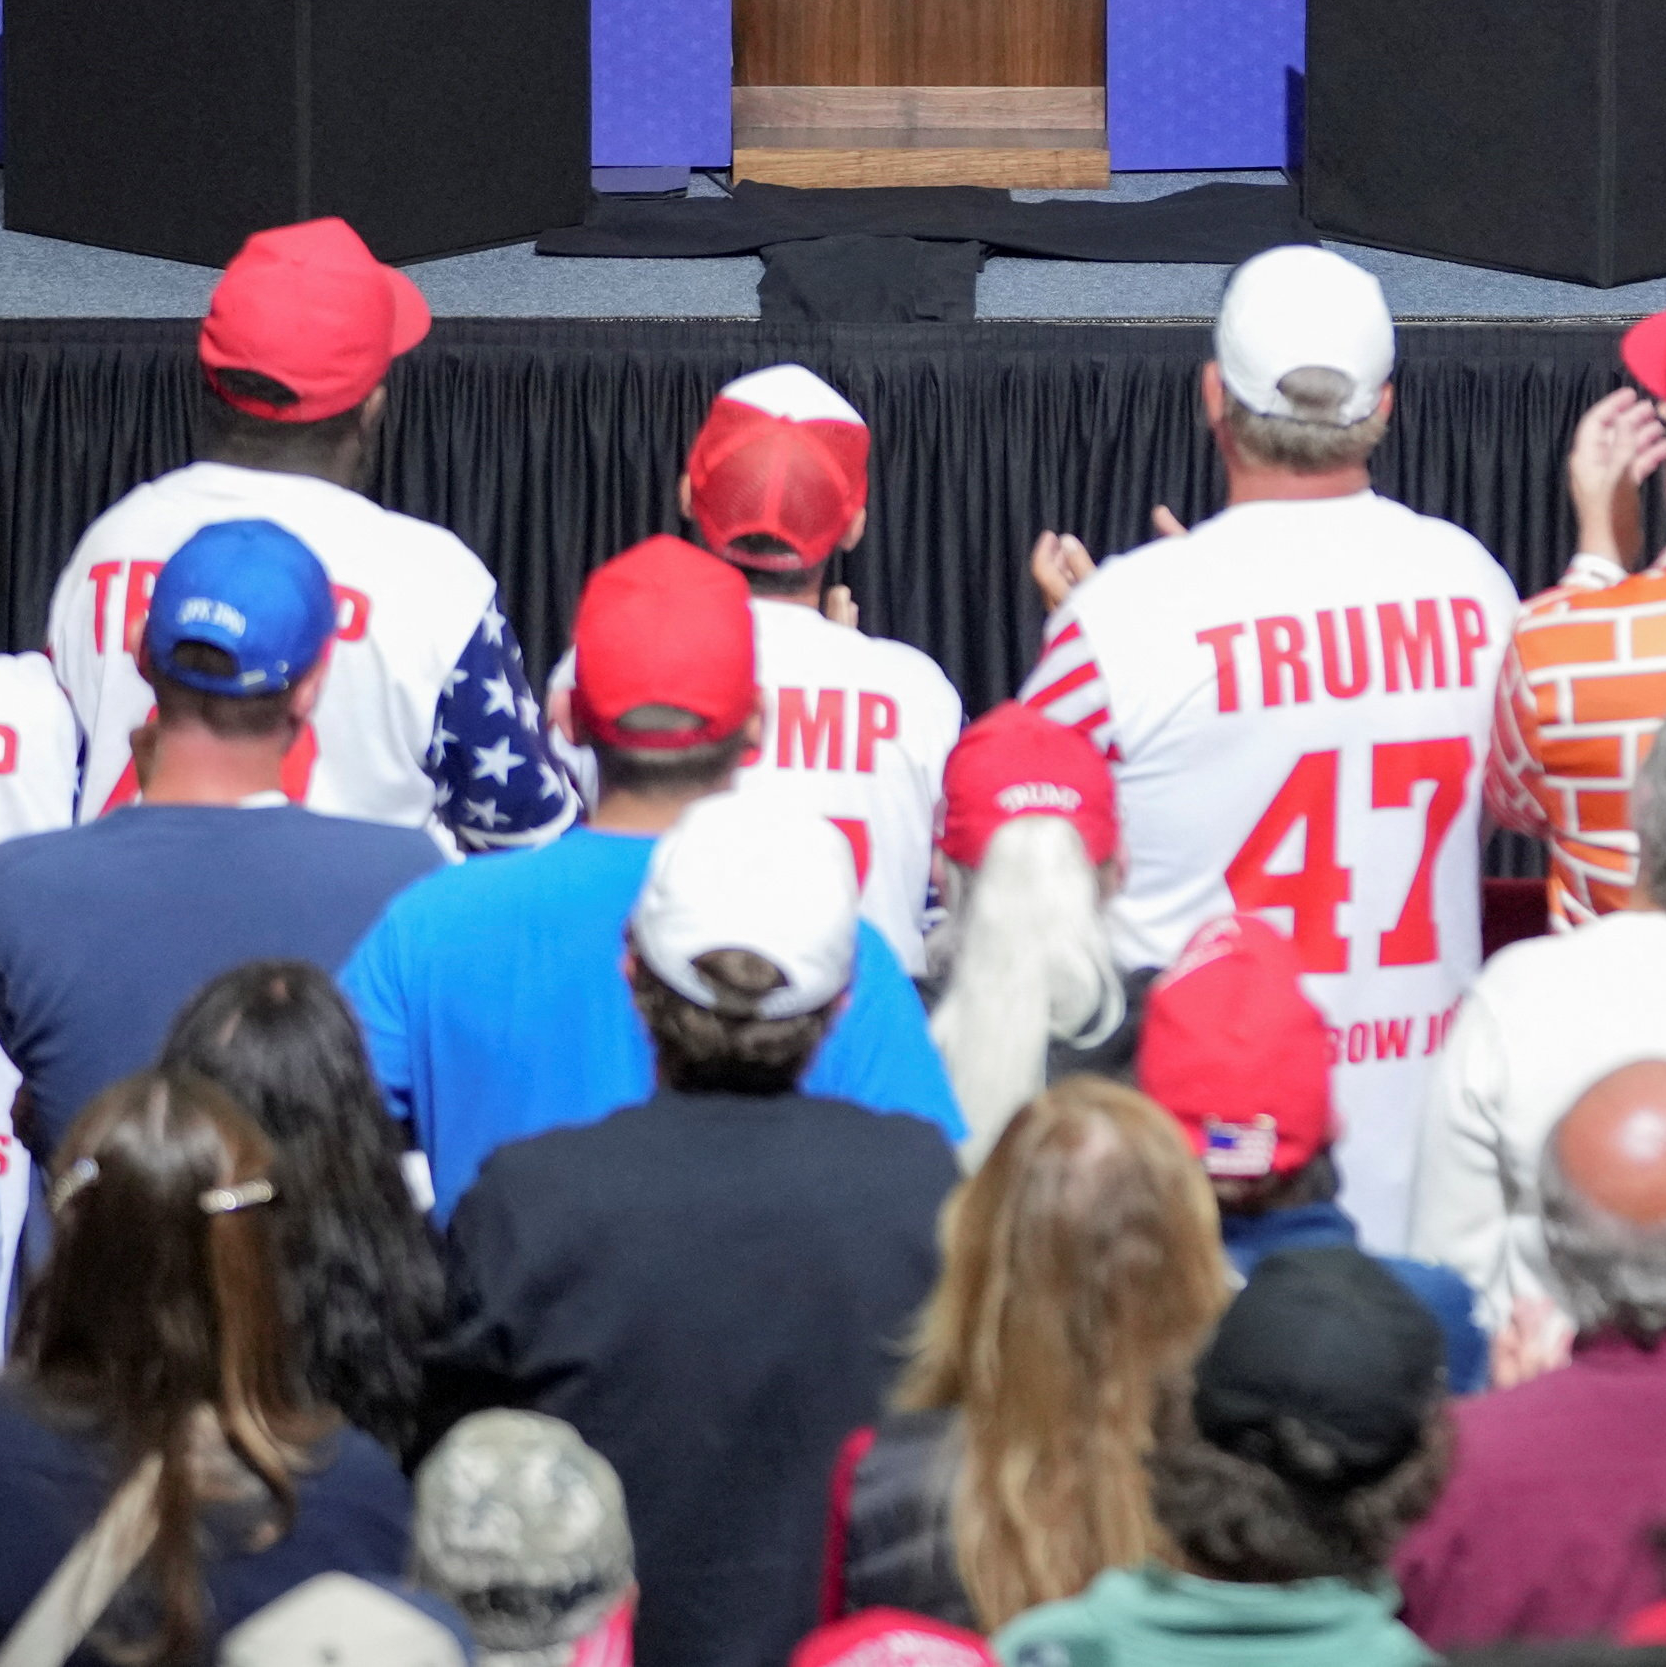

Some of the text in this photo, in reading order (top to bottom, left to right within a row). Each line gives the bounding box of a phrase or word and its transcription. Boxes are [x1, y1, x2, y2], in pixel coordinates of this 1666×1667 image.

[1195, 596, 1490, 715] TRUMP
[996, 781, 1083, 814] TRUMP
[1223, 737, 1475, 974] 47
